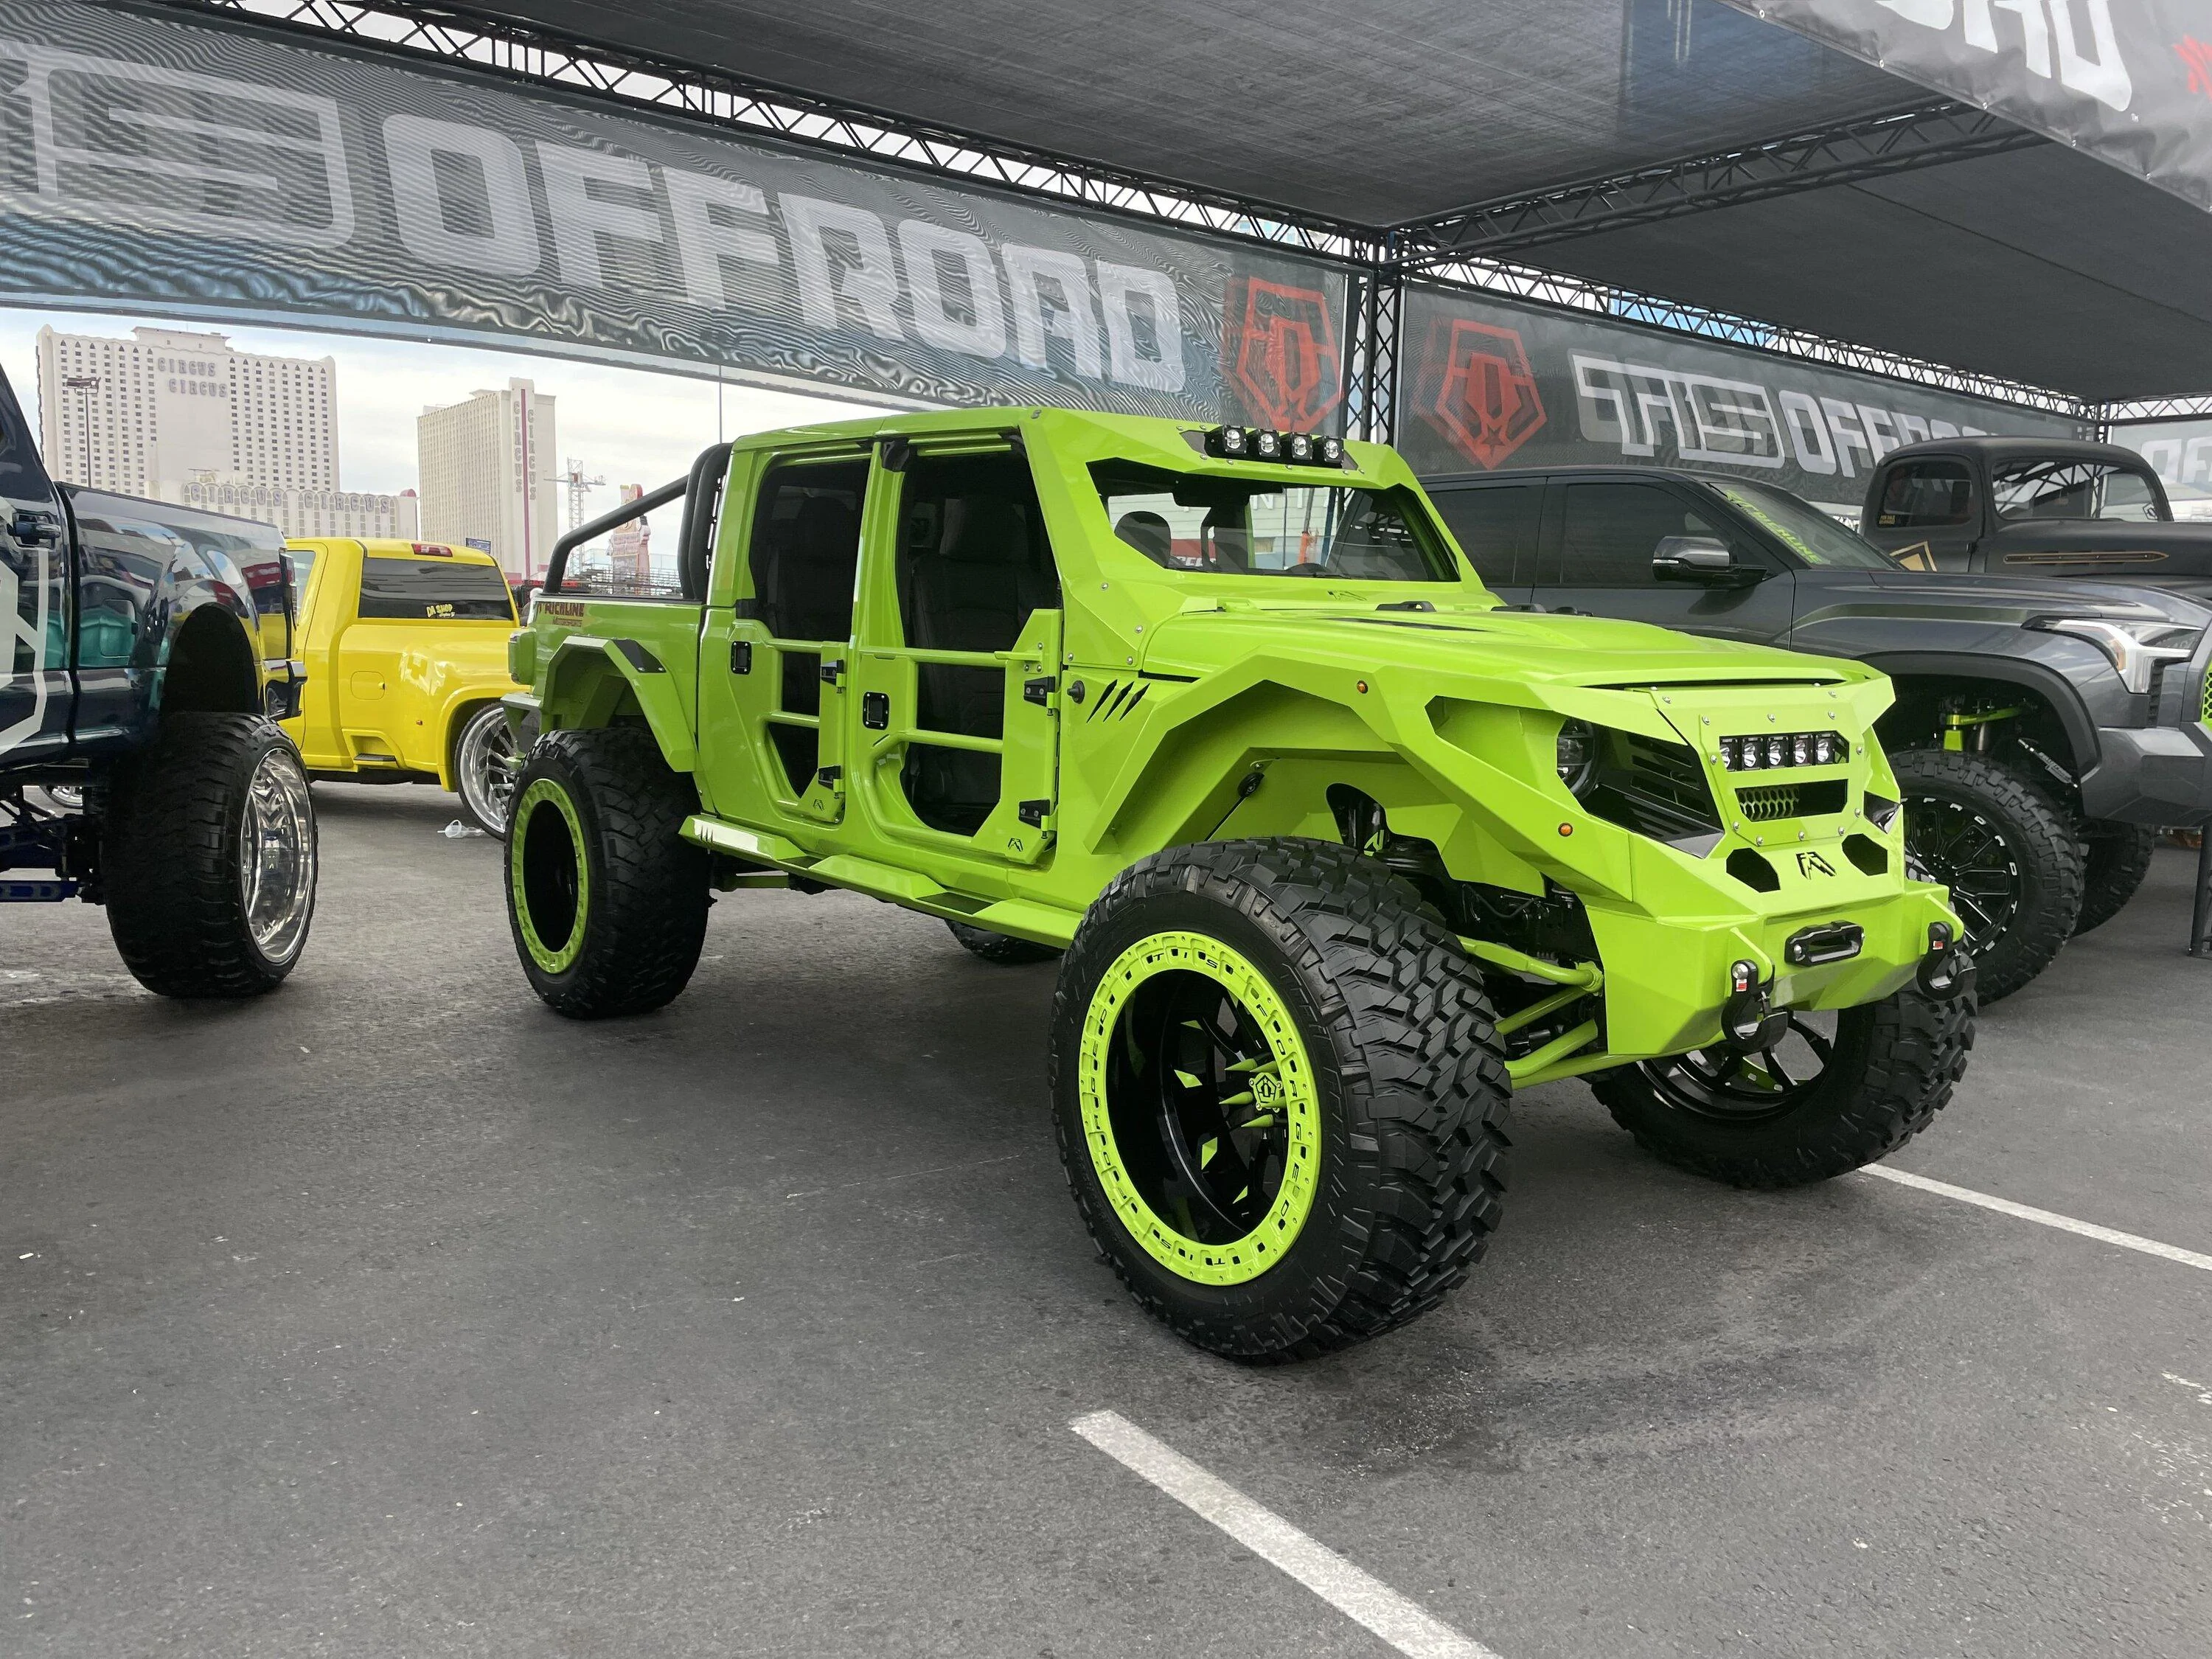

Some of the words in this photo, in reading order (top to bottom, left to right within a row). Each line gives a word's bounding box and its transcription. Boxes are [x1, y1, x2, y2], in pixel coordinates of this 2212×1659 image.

[382, 114, 1185, 392] OFFROAD
[157, 357, 216, 377] CIRCUS
[168, 378, 228, 397] CIRCUS
[513, 401, 522, 493] CIRCUS
[527, 409, 536, 500] CIRCUS
[190, 484, 281, 506] CIRCUS
[304, 494, 390, 513] CIRCUS
[1152, 952, 1219, 970] TIS
[1256, 1004, 1301, 1217] FORGED
[1160, 1236, 1226, 1265] TIS
